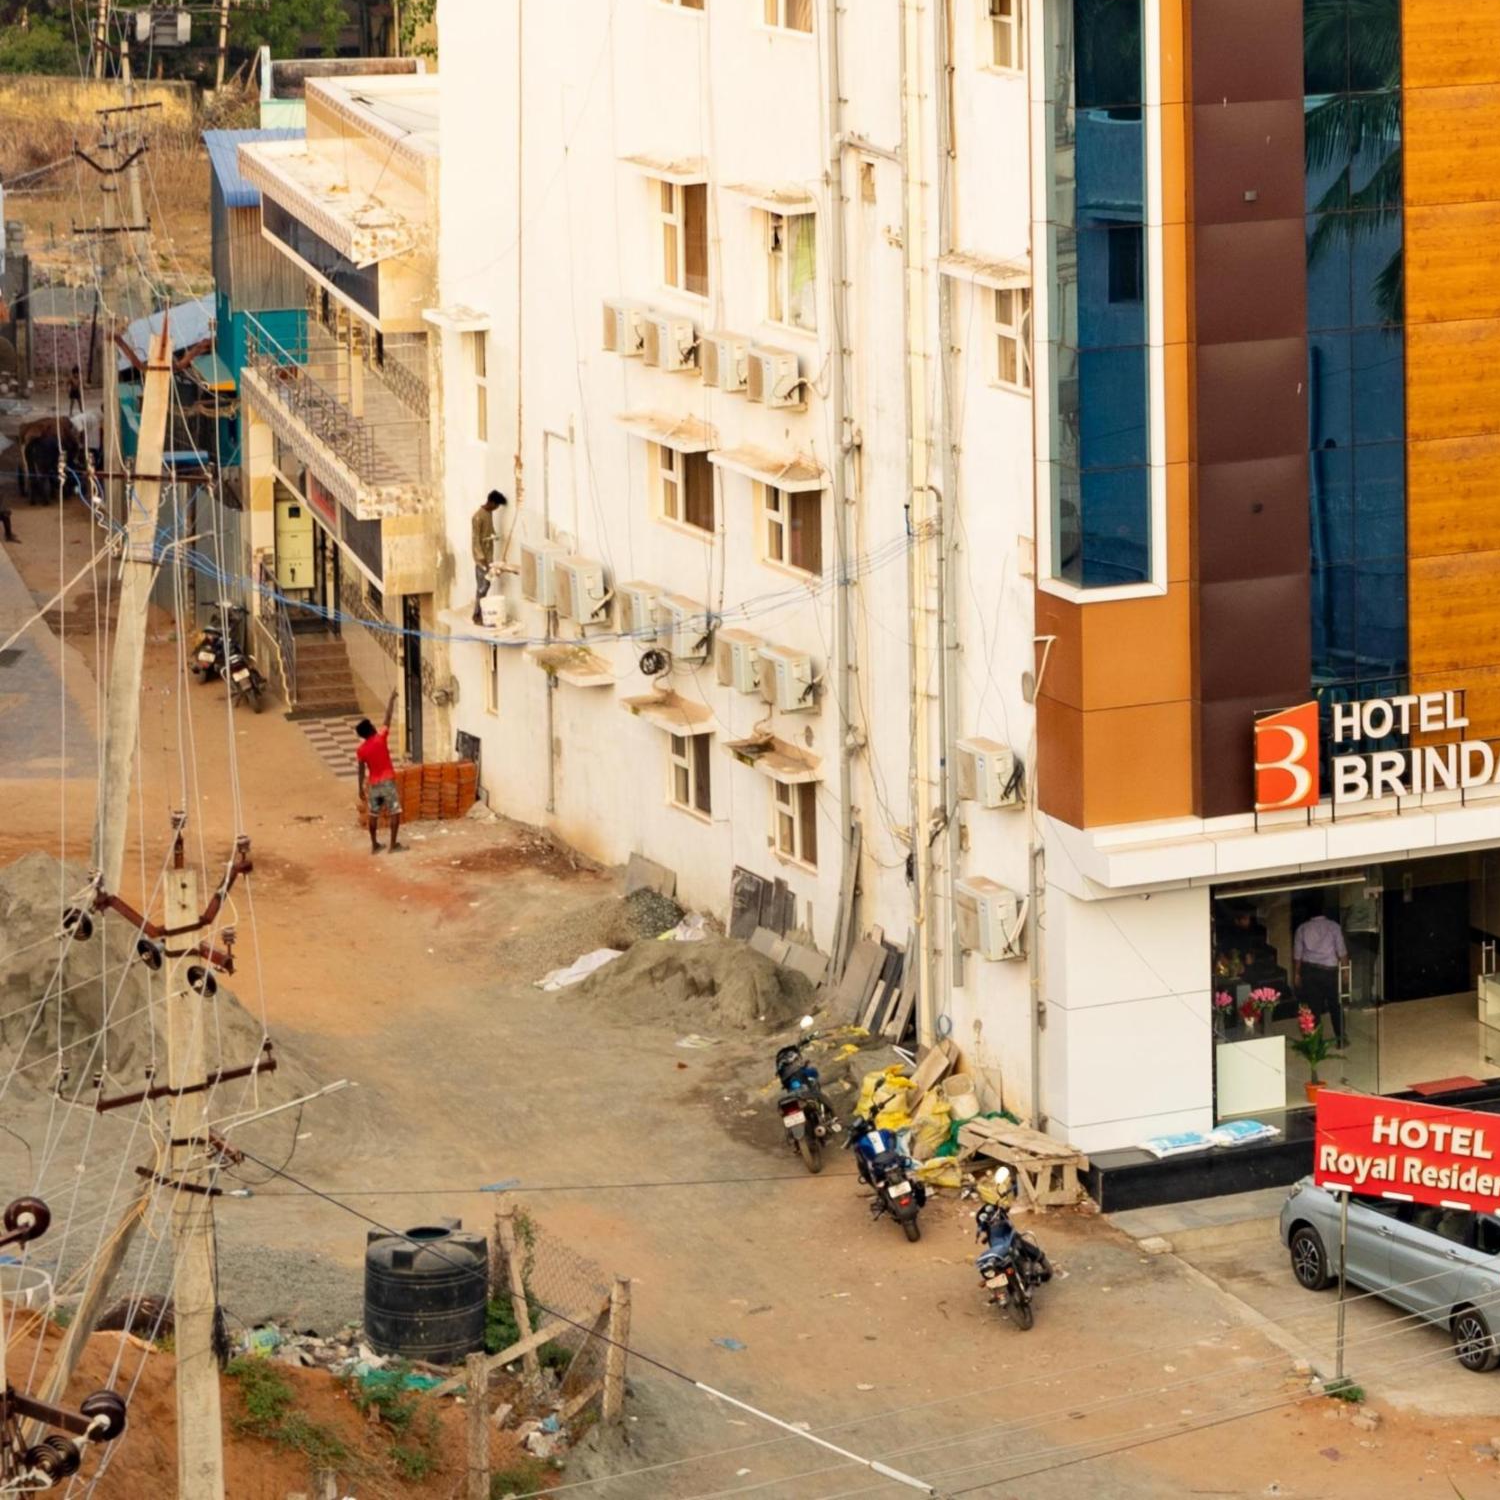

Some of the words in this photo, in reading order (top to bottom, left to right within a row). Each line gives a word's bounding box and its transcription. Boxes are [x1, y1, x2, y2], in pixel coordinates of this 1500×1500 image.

[1333, 691, 1469, 743] HOTEL
[1372, 1115, 1492, 1159] HOTEL
[1320, 1145, 1395, 1183] Royal
